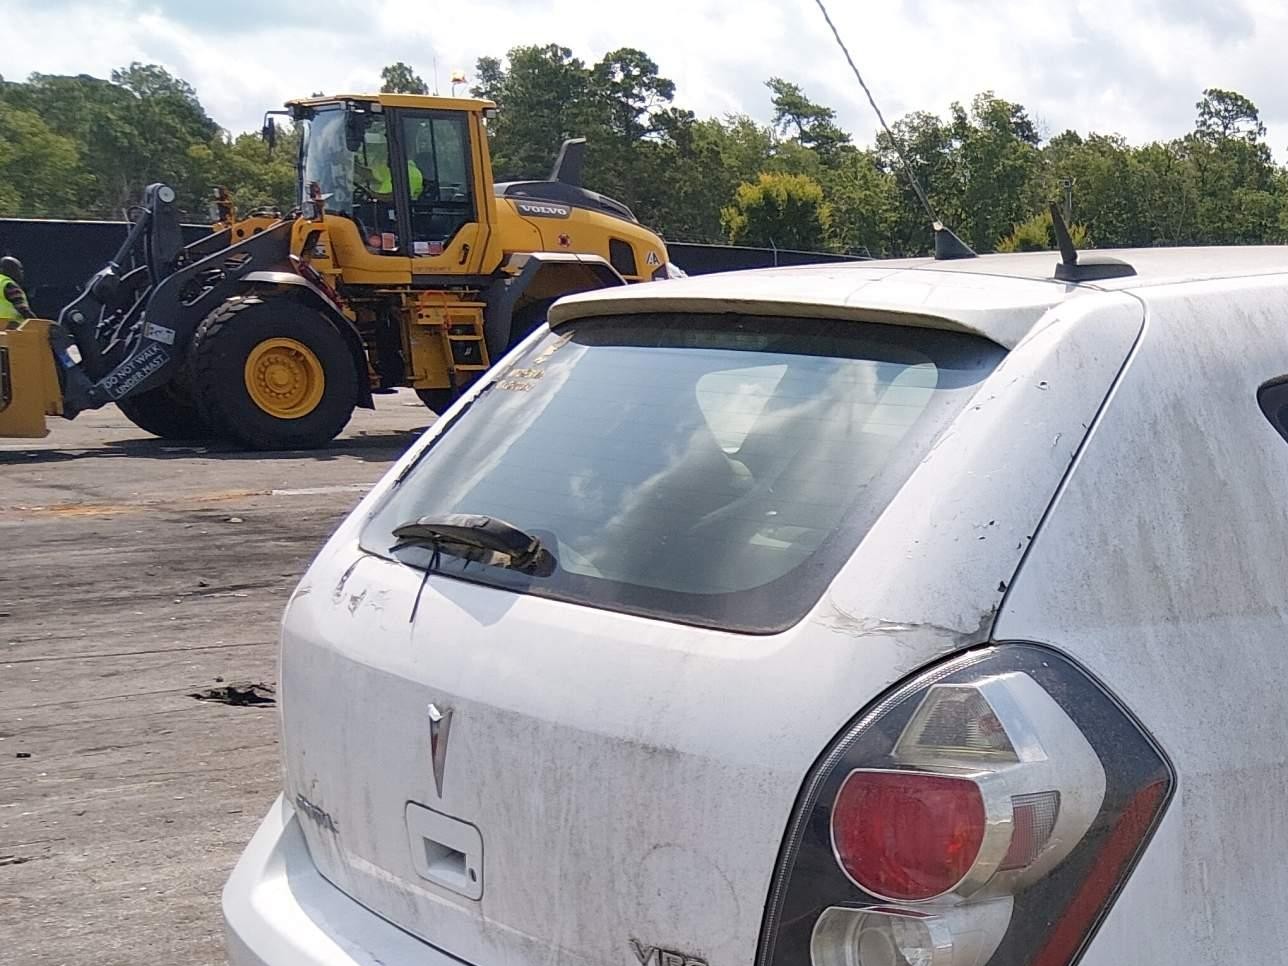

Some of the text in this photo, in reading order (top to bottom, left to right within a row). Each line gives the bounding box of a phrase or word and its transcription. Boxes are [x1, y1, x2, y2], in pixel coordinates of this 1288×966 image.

[519, 204, 568, 216] VOLVO
[104, 344, 162, 389] DO NOT WALK
[116, 355, 164, 394] UNDER MAST
